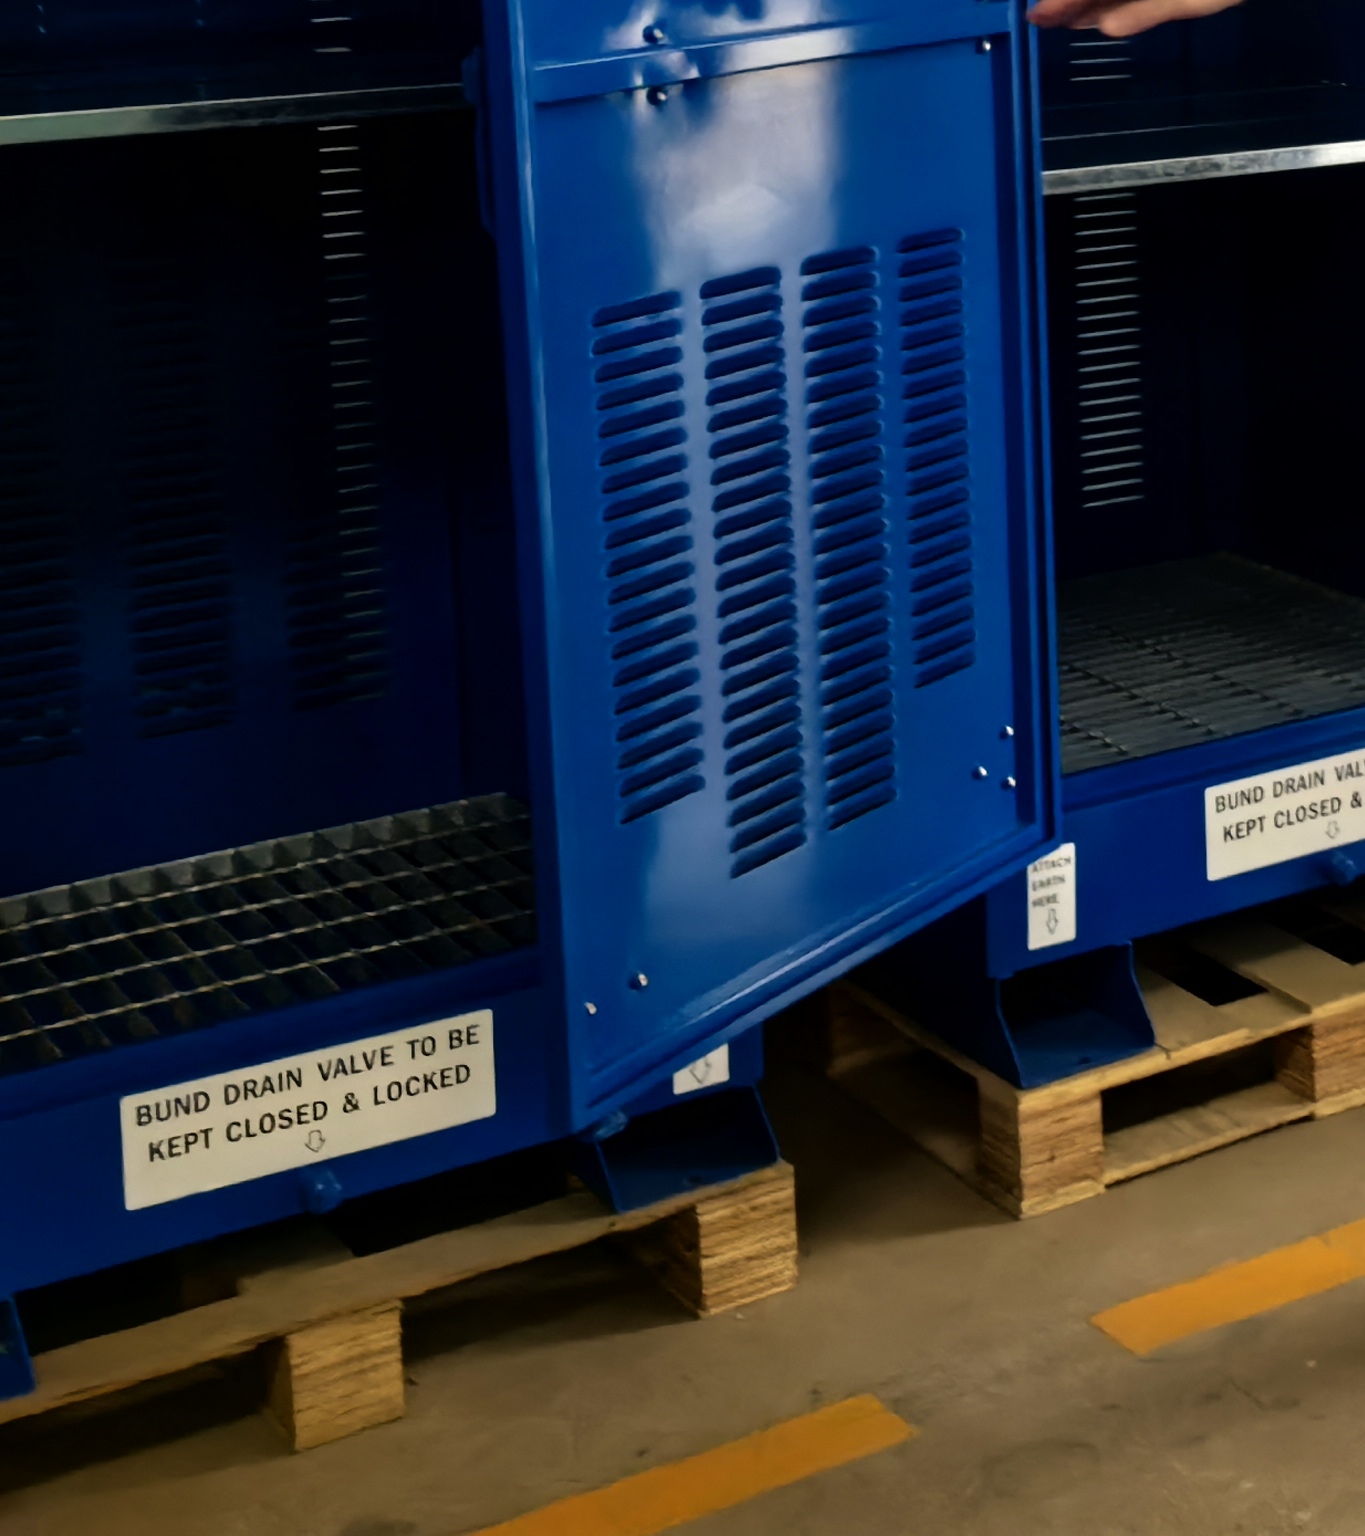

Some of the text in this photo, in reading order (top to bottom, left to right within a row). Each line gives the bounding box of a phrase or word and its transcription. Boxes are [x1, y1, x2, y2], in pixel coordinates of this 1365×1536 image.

[1215, 786, 1264, 814] BUND
[1273, 771, 1325, 798] DRAIN
[1223, 815, 1266, 843] KEPT
[1273, 796, 1342, 829] CLOSED
[1350, 791, 1363, 809] &
[136, 1024, 480, 1127] BUND DRAIN VALVE TO BE
[148, 1064, 471, 1163] KEPT CLOSED & LOCKED
